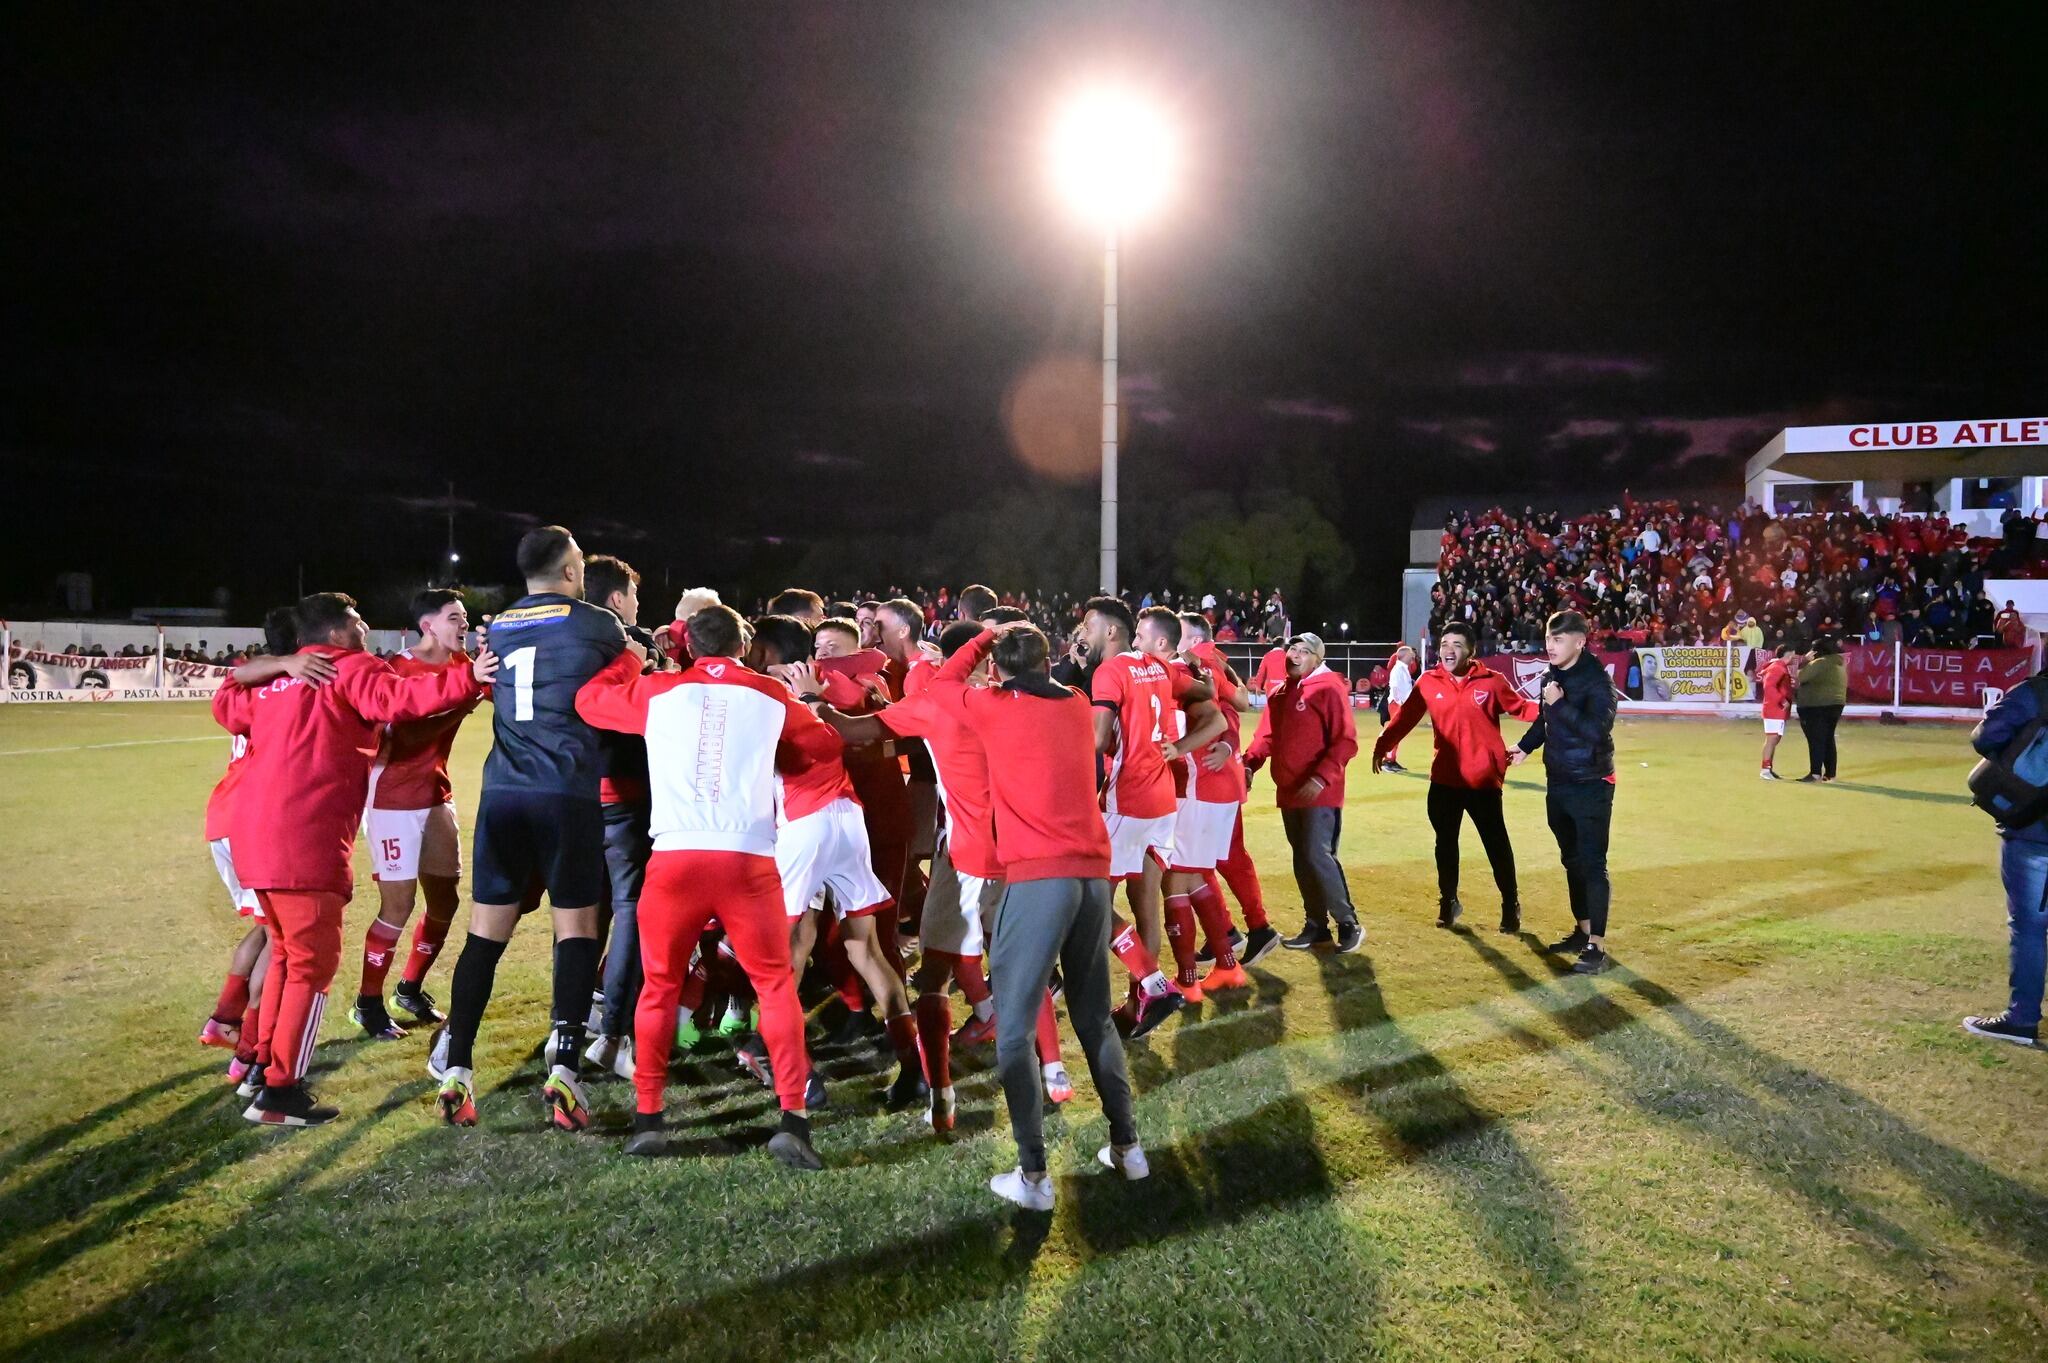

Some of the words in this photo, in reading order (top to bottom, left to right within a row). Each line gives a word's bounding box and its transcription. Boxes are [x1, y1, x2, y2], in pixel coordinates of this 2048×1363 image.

[1849, 426, 1938, 447] CLUB
[25, 650, 87, 668] ATLETICO
[90, 657, 150, 670] LAMBERT
[1662, 648, 1674, 658] LA
[1674, 648, 1740, 658] COOPERATIA
[172, 661, 208, 678] 1922
[1665, 659, 1682, 668] LOS
[1976, 657, 1993, 672] A
[1661, 670, 1677, 679] POR
[1679, 670, 1713, 679] SIEMPRE
[503, 646, 537, 721] 1
[10, 691, 64, 701] NOSTRA
[124, 689, 160, 699] PASTA
[167, 690, 184, 698] LA
[1151, 694, 1163, 742] 2
[695, 696, 727, 803] LAMBERT
[382, 838, 401, 861] 15
